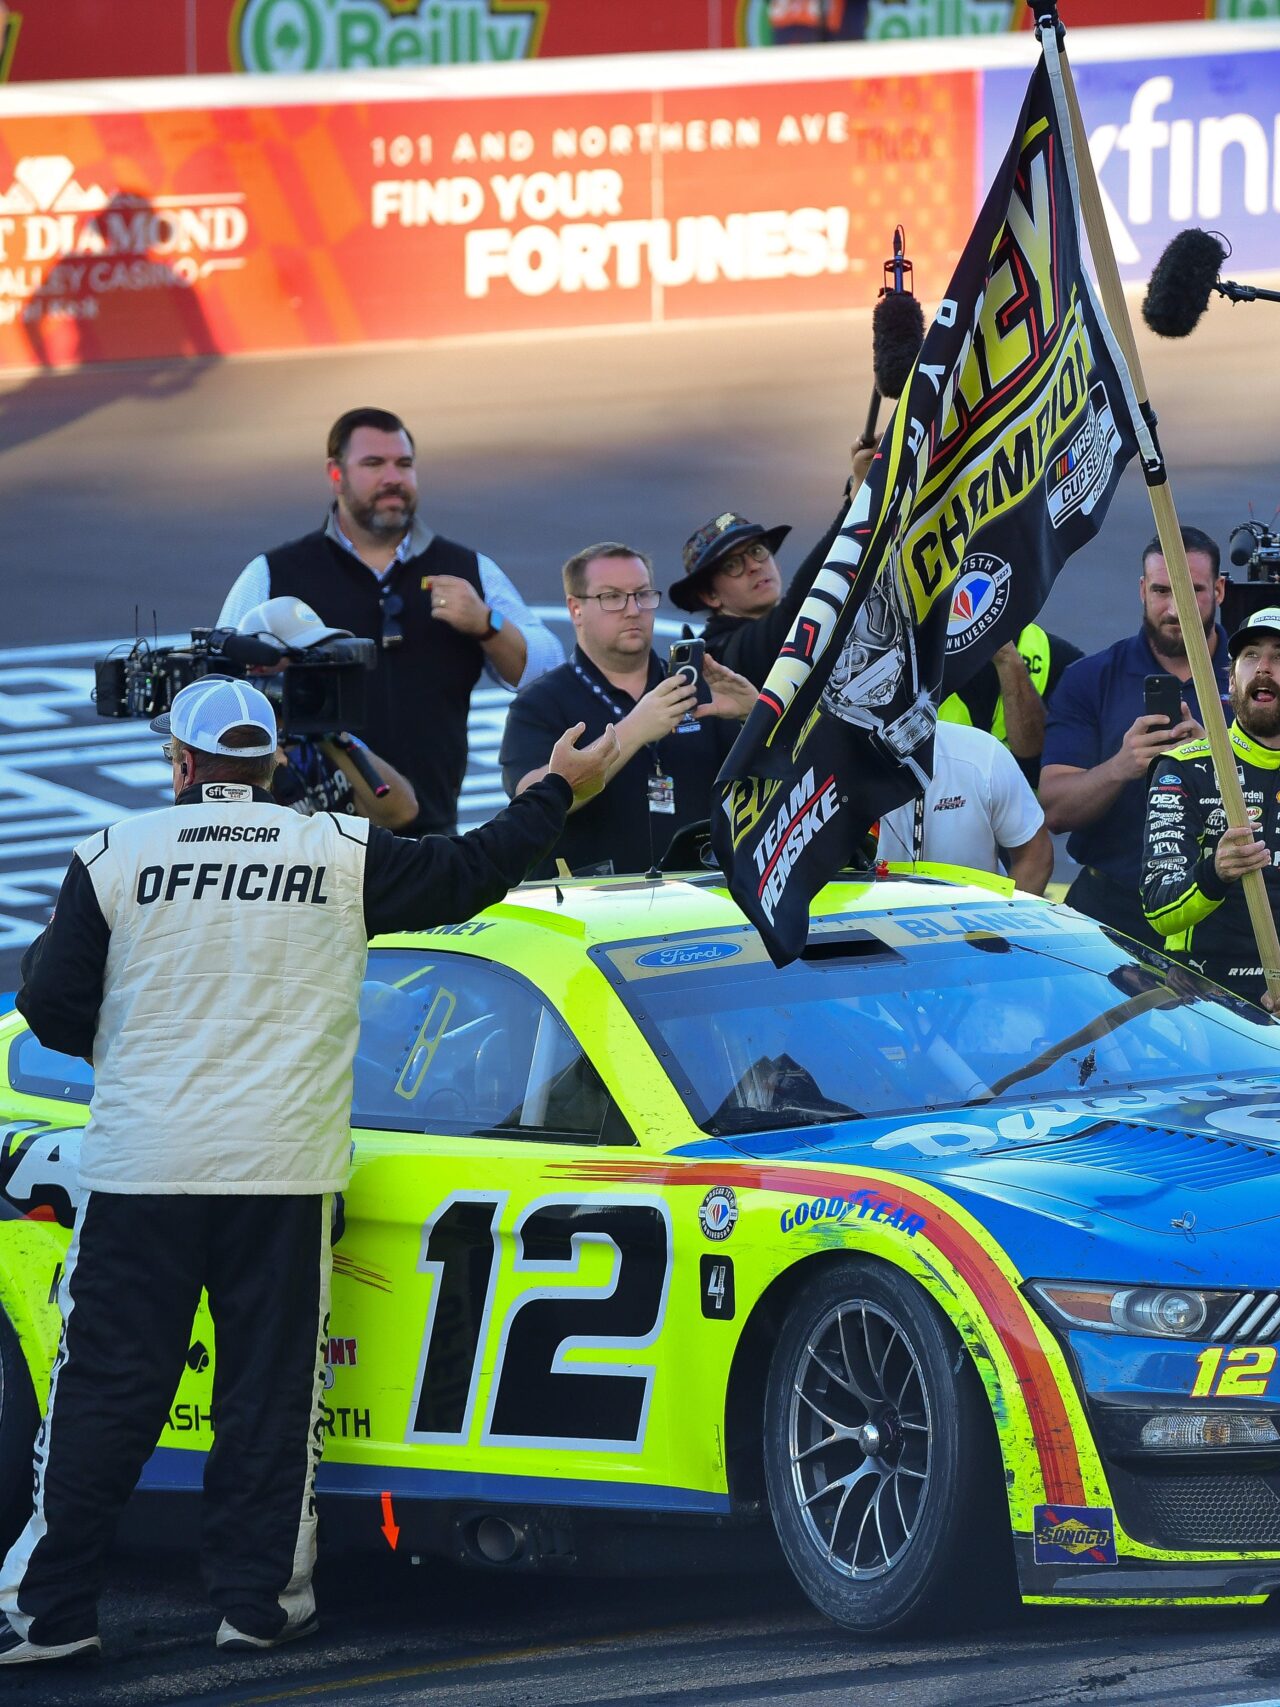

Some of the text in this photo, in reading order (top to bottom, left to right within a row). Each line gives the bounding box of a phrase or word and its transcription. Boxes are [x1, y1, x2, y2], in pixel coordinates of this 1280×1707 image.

[371, 112, 850, 167] 101 AND NORTHERN AVE
[372, 168, 623, 229] FIND YOUR
[23, 205, 248, 262] DIAMOND
[465, 205, 850, 297] FORTUNES!
[89, 256, 199, 293] CASINO
[1062, 472, 1086, 504] CUP
[963, 557, 994, 572] 75TH
[208, 786, 222, 796] sfi
[933, 800, 967, 813] PENSKE
[938, 795, 962, 804] TEAM
[1150, 793, 1182, 805] DEX
[205, 825, 280, 843] NASCAR
[752, 765, 817, 877] TEAM
[1148, 829, 1185, 843] Mazak
[760, 780, 840, 928] PENSKE
[137, 863, 328, 904] OFFICIAL
[396, 921, 497, 936] ANEY
[898, 905, 1063, 940] BLANEY
[661, 943, 723, 966] Ford
[1228, 968, 1264, 976] RYAN
[707, 1265, 727, 1310] 4
[404, 1190, 674, 1454] 12
[1191, 1346, 1278, 1398] 12
[1038, 1525, 1113, 1545] SUNOCO
